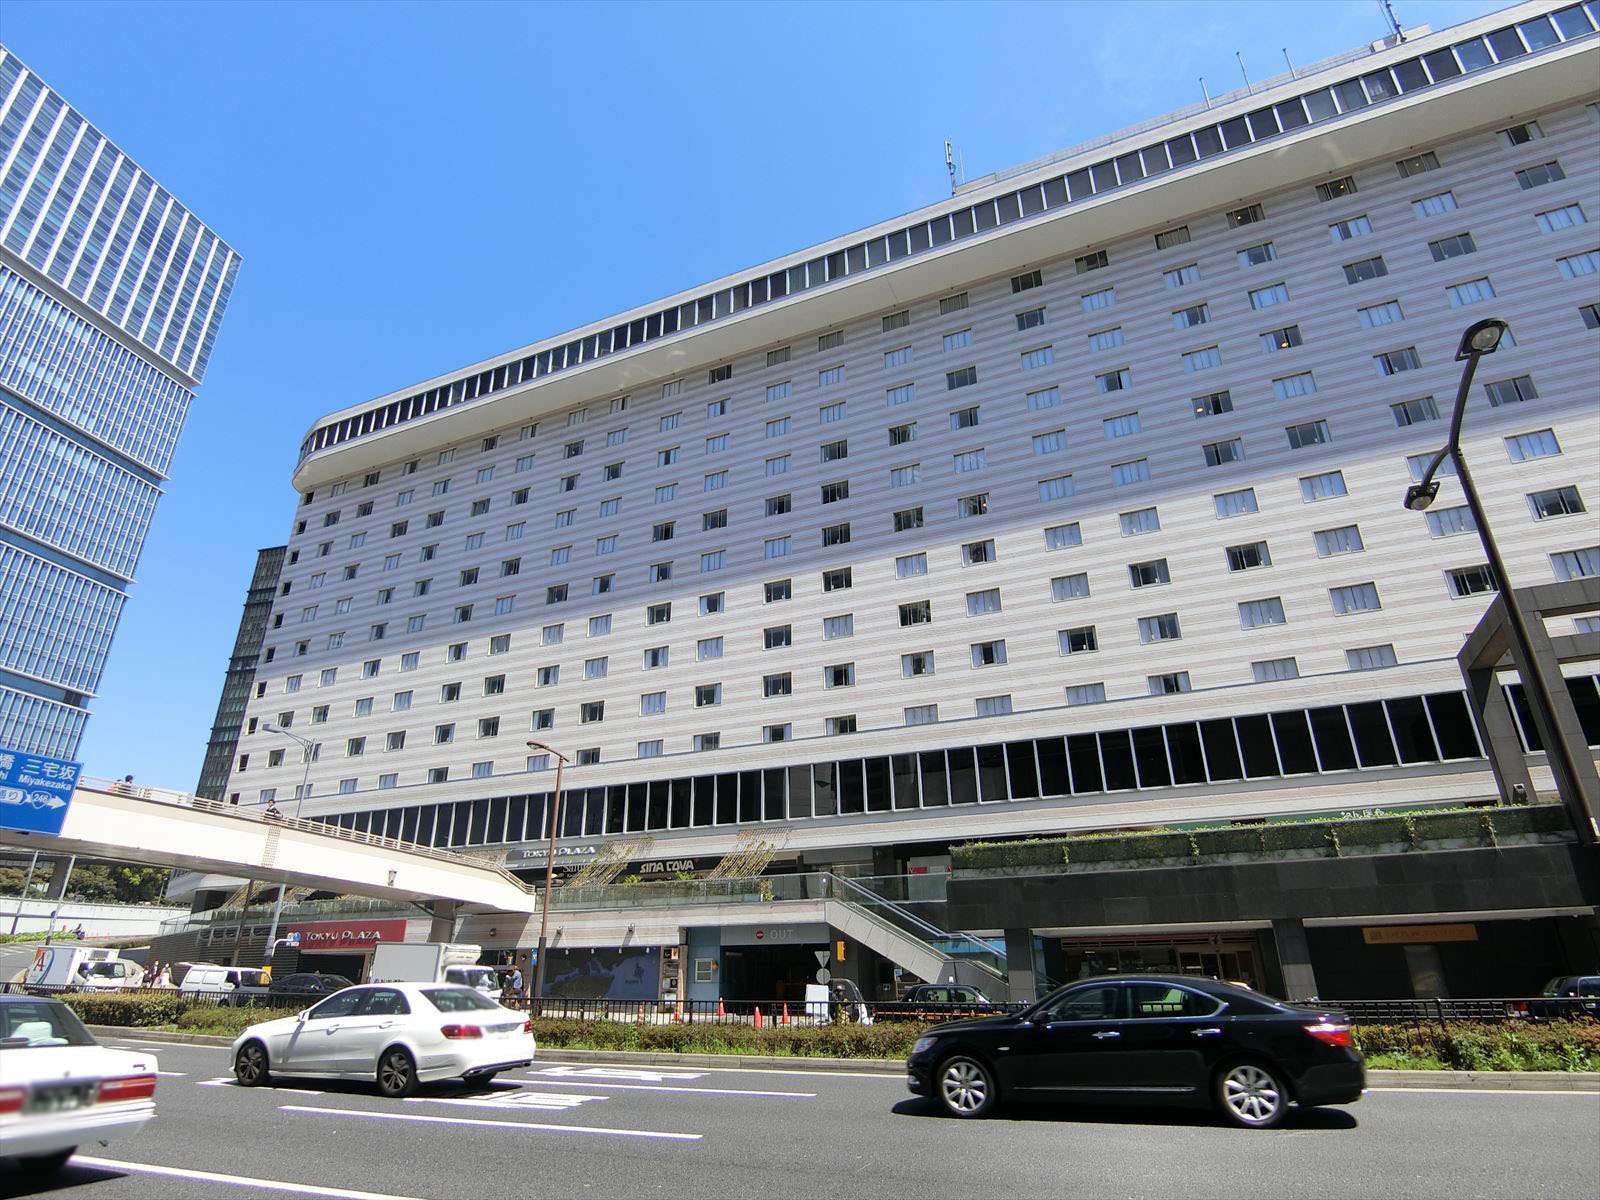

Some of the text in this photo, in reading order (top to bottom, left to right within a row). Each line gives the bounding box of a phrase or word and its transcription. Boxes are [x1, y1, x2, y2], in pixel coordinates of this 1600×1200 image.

[23, 758, 77, 781] 三宅坂
[18, 774, 72, 790] Miyakezaka
[33, 793, 49, 803] 246
[558, 846, 596, 856] PLAZA
[666, 860, 694, 872] COVA
[305, 930, 381, 941] TOKYU PLAZA
[769, 929, 794, 940] OUT
